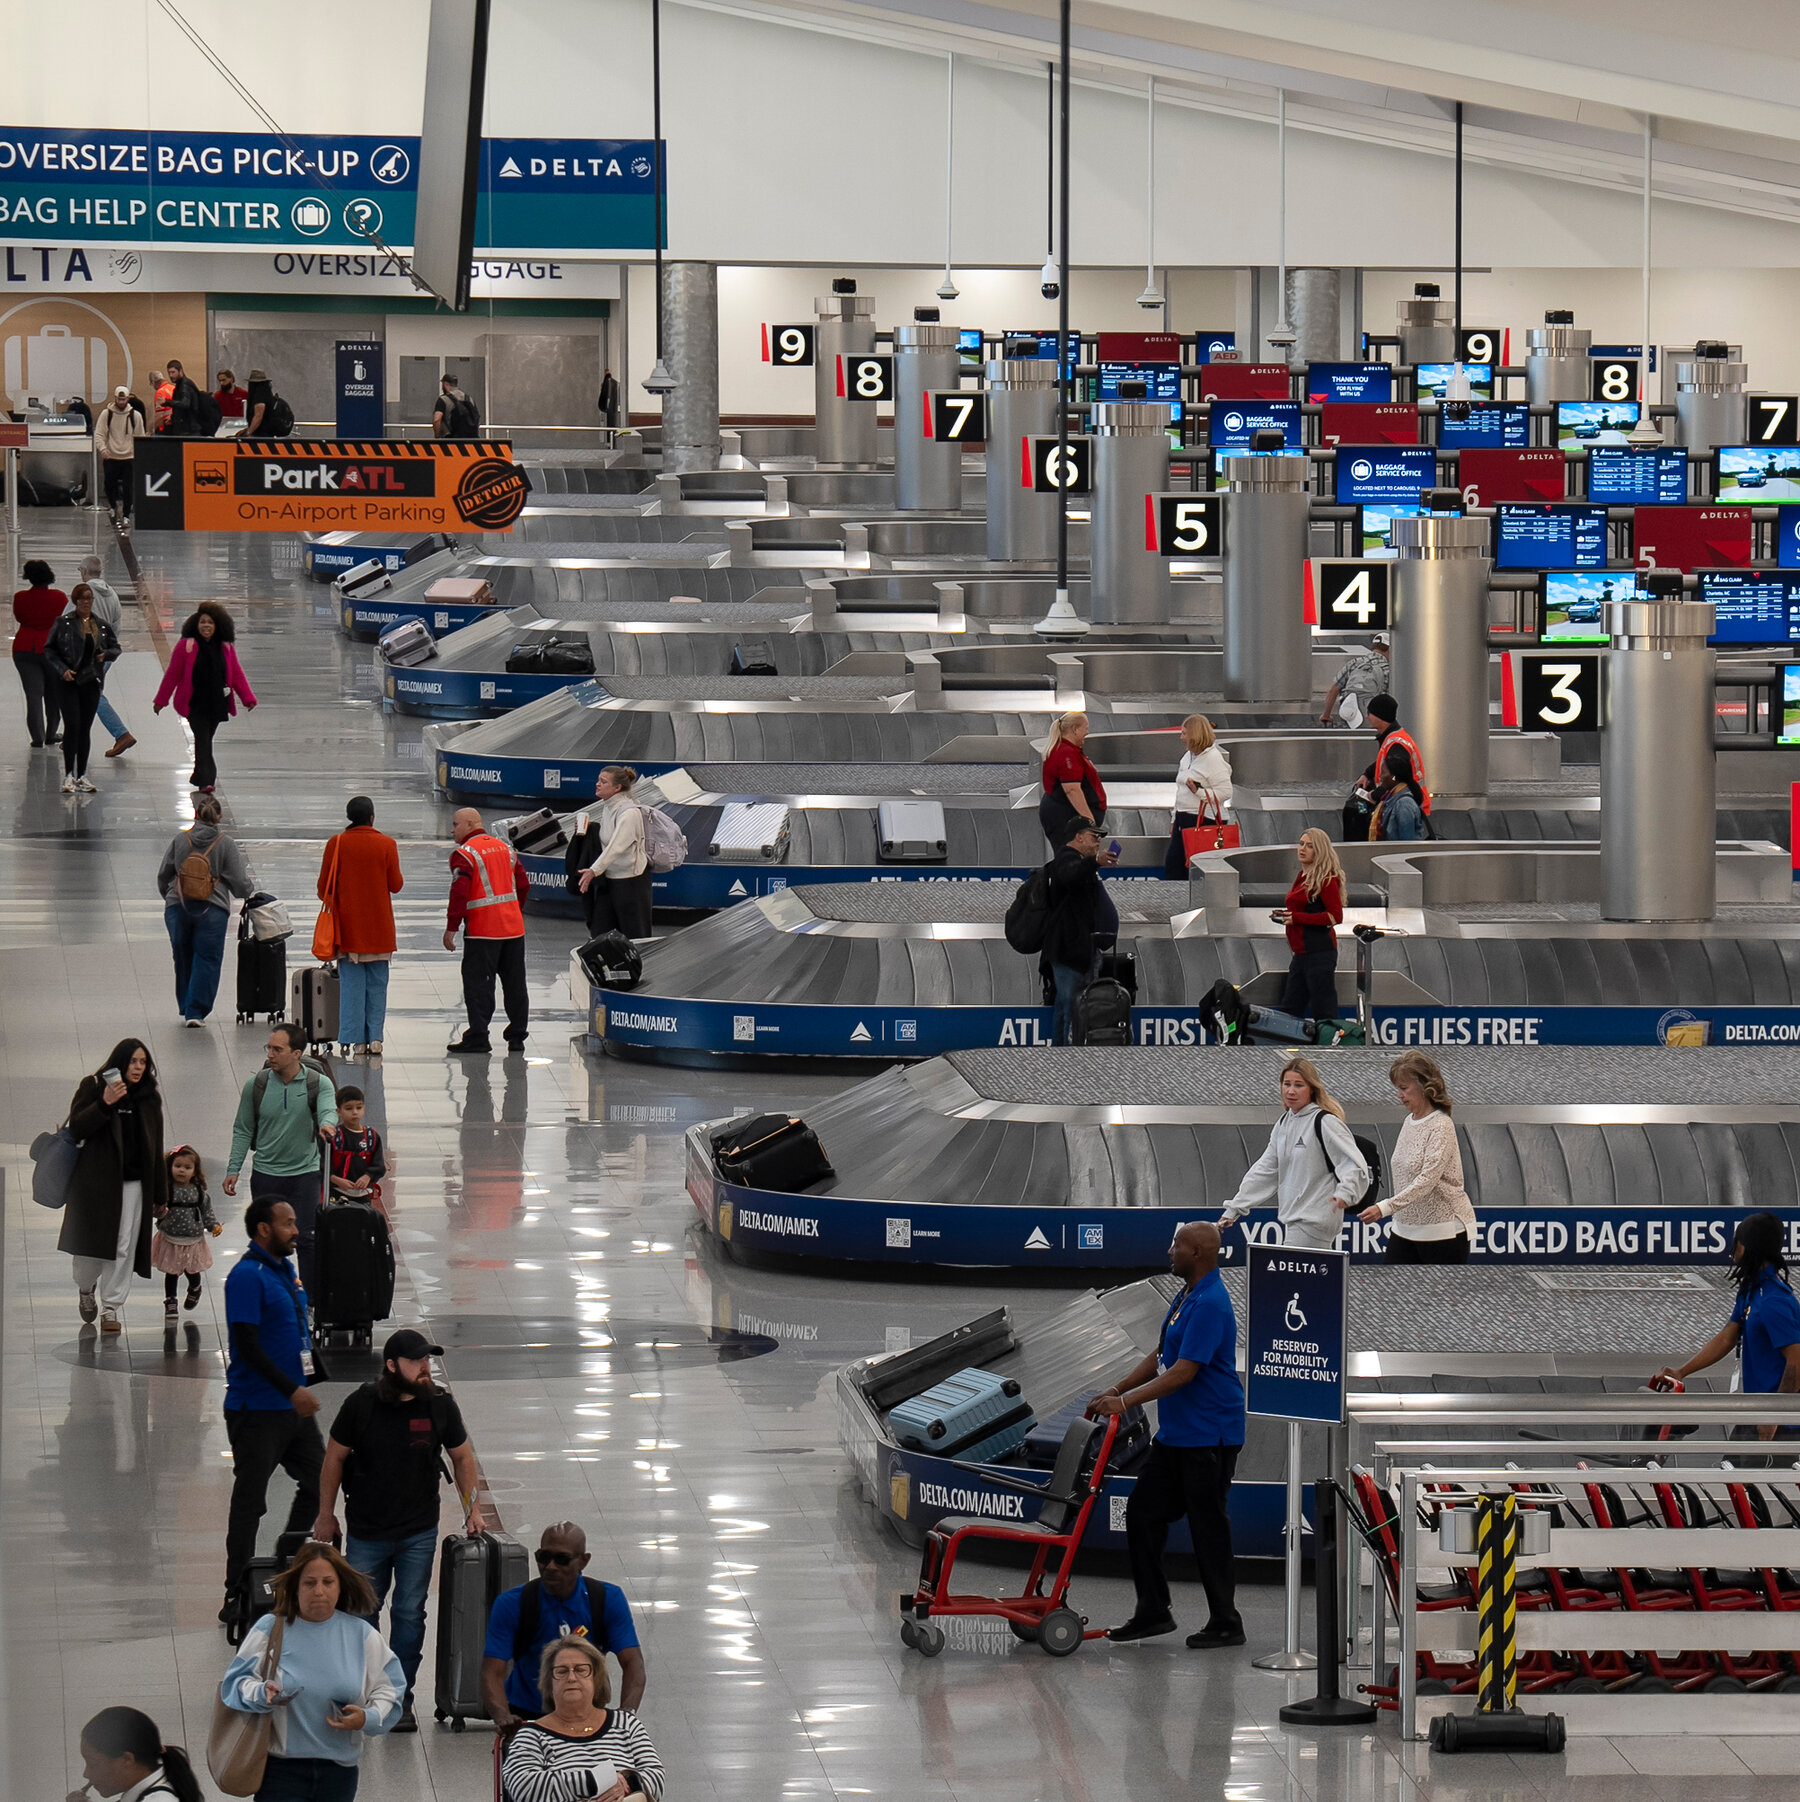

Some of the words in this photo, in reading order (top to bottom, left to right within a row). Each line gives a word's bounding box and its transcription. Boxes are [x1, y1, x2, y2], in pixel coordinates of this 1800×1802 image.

[0, 142, 148, 173] OVERSIZE
[157, 146, 223, 174] BAG
[233, 147, 360, 177] PICK-UP
[530, 158, 623, 176] DELTA
[69, 198, 147, 226] HELP
[156, 200, 281, 229] CENTER
[779, 328, 805, 363] 9
[1214, 352, 1239, 360] AED
[1466, 333, 1493, 363] 9
[856, 360, 883, 397] 8
[1601, 364, 1630, 401] 8
[945, 398, 974, 438] 7
[1760, 401, 1789, 440] 7
[1045, 445, 1079, 487] 6
[461, 474, 523, 511] DETOUR
[1463, 484, 1480, 508] 6
[237, 502, 357, 524] On-Airport
[364, 502, 446, 524] Parking
[1709, 511, 1741, 519] DELTA
[1173, 503, 1208, 550] 5
[1638, 546, 1657, 568] 5
[1703, 574, 1710, 583] 4
[1331, 570, 1377, 624] 4
[397, 679, 443, 695] DELTA.COM/AMEX
[1538, 664, 1582, 725] 3
[450, 766, 502, 783] DELTA.COM/AMEX
[610, 1009, 678, 1034] DELTA.COM/AMEX
[901, 1023, 916, 1031] AM
[903, 1030, 916, 1038] EX
[998, 1018, 1052, 1047] ATL,
[1404, 1018, 1471, 1045] FLIES
[738, 1208, 820, 1238] DELTA.COM/AMEX
[927, 1230, 941, 1238] MORE
[1084, 1228, 1102, 1237] AM
[1087, 1236, 1102, 1245] EX
[1470, 1220, 1568, 1254] ECKED
[1575, 1220, 1639, 1254] BAG
[1646, 1220, 1727, 1254] FLIES
[1279, 1260, 1317, 1275] DELTA
[1272, 1339, 1319, 1354] RESERVED
[1263, 1352, 1281, 1364] FOR
[1283, 1353, 1329, 1368] MOBILITY
[1253, 1364, 1310, 1381] ASSISTANCE
[1311, 1370, 1339, 1383] ONLY
[919, 1482, 1024, 1518] DELTA.COM/AMEX
